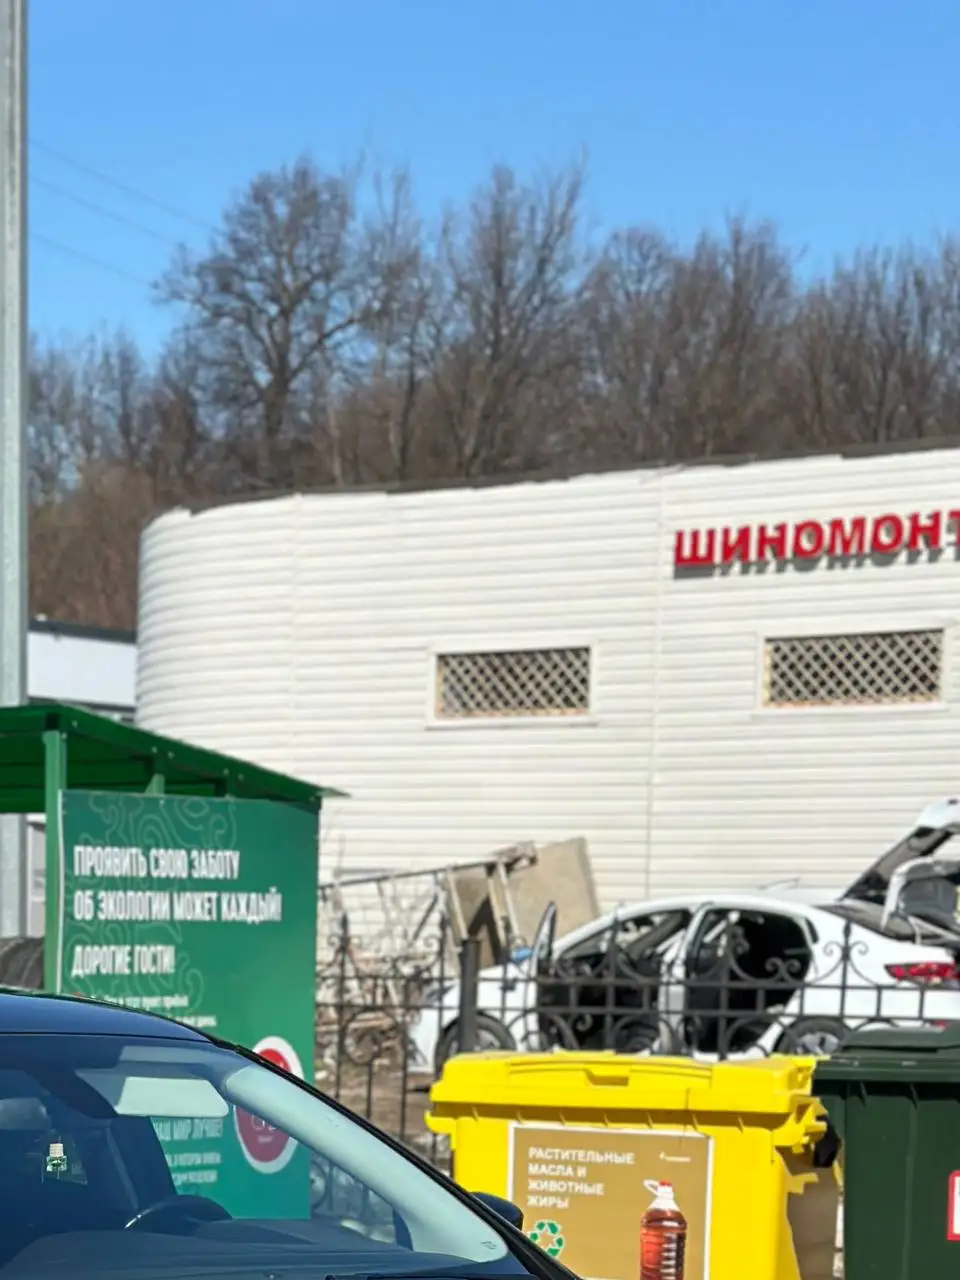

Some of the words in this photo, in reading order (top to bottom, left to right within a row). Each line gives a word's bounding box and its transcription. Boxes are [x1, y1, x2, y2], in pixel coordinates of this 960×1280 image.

[74, 846, 148, 877] ПРОЯВИТЬ
[149, 847, 189, 878] СВОЮ
[191, 849, 240, 879] ЗАБОТУ
[74, 890, 94, 920] ОБ
[97, 890, 171, 920] ЭКОЛОГИИ
[173, 891, 218, 921] МОЖЕТ
[71, 945, 131, 978] ДОРОГИЕ
[528, 1147, 635, 1164] РАСТИТЕЛЬНЫЕ
[528, 1163, 573, 1177] МАСЛА
[577, 1166, 587, 1178] И
[528, 1179, 604, 1195] ЖИВОТНЫЕ
[527, 1195, 569, 1209] ЖИРЫ
